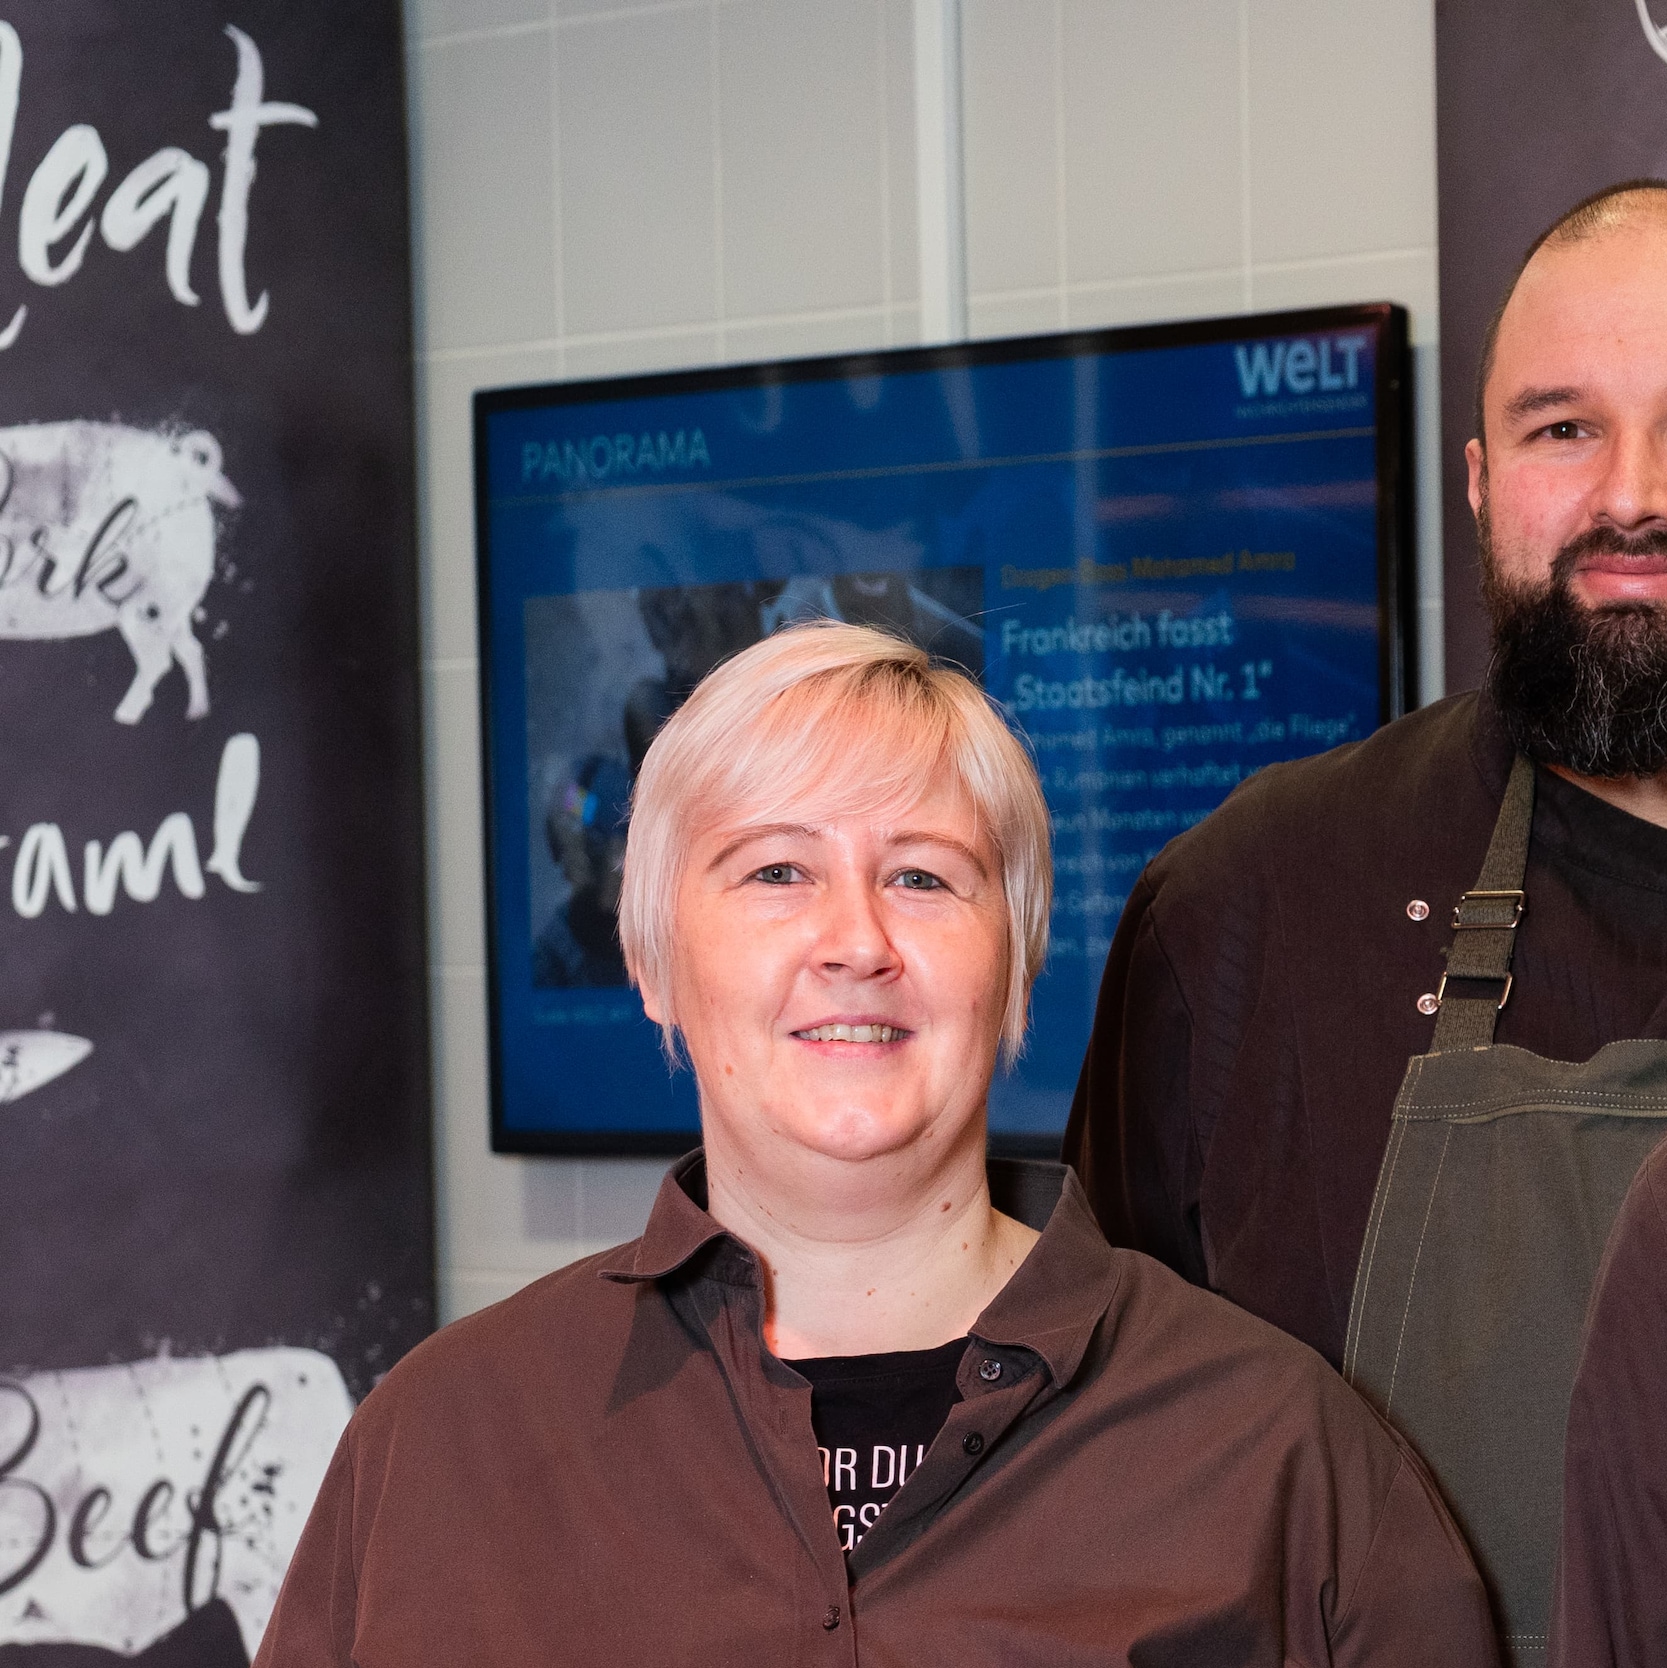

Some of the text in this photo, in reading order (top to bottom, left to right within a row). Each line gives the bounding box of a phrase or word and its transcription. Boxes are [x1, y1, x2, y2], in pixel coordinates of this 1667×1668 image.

[521, 428, 711, 483] PANORAMA
[1001, 609, 1237, 656] Frankreich fasst
[1191, 663, 1236, 703] Nr.
[0, 731, 266, 919] aml
[833, 1502, 889, 1551] GS
